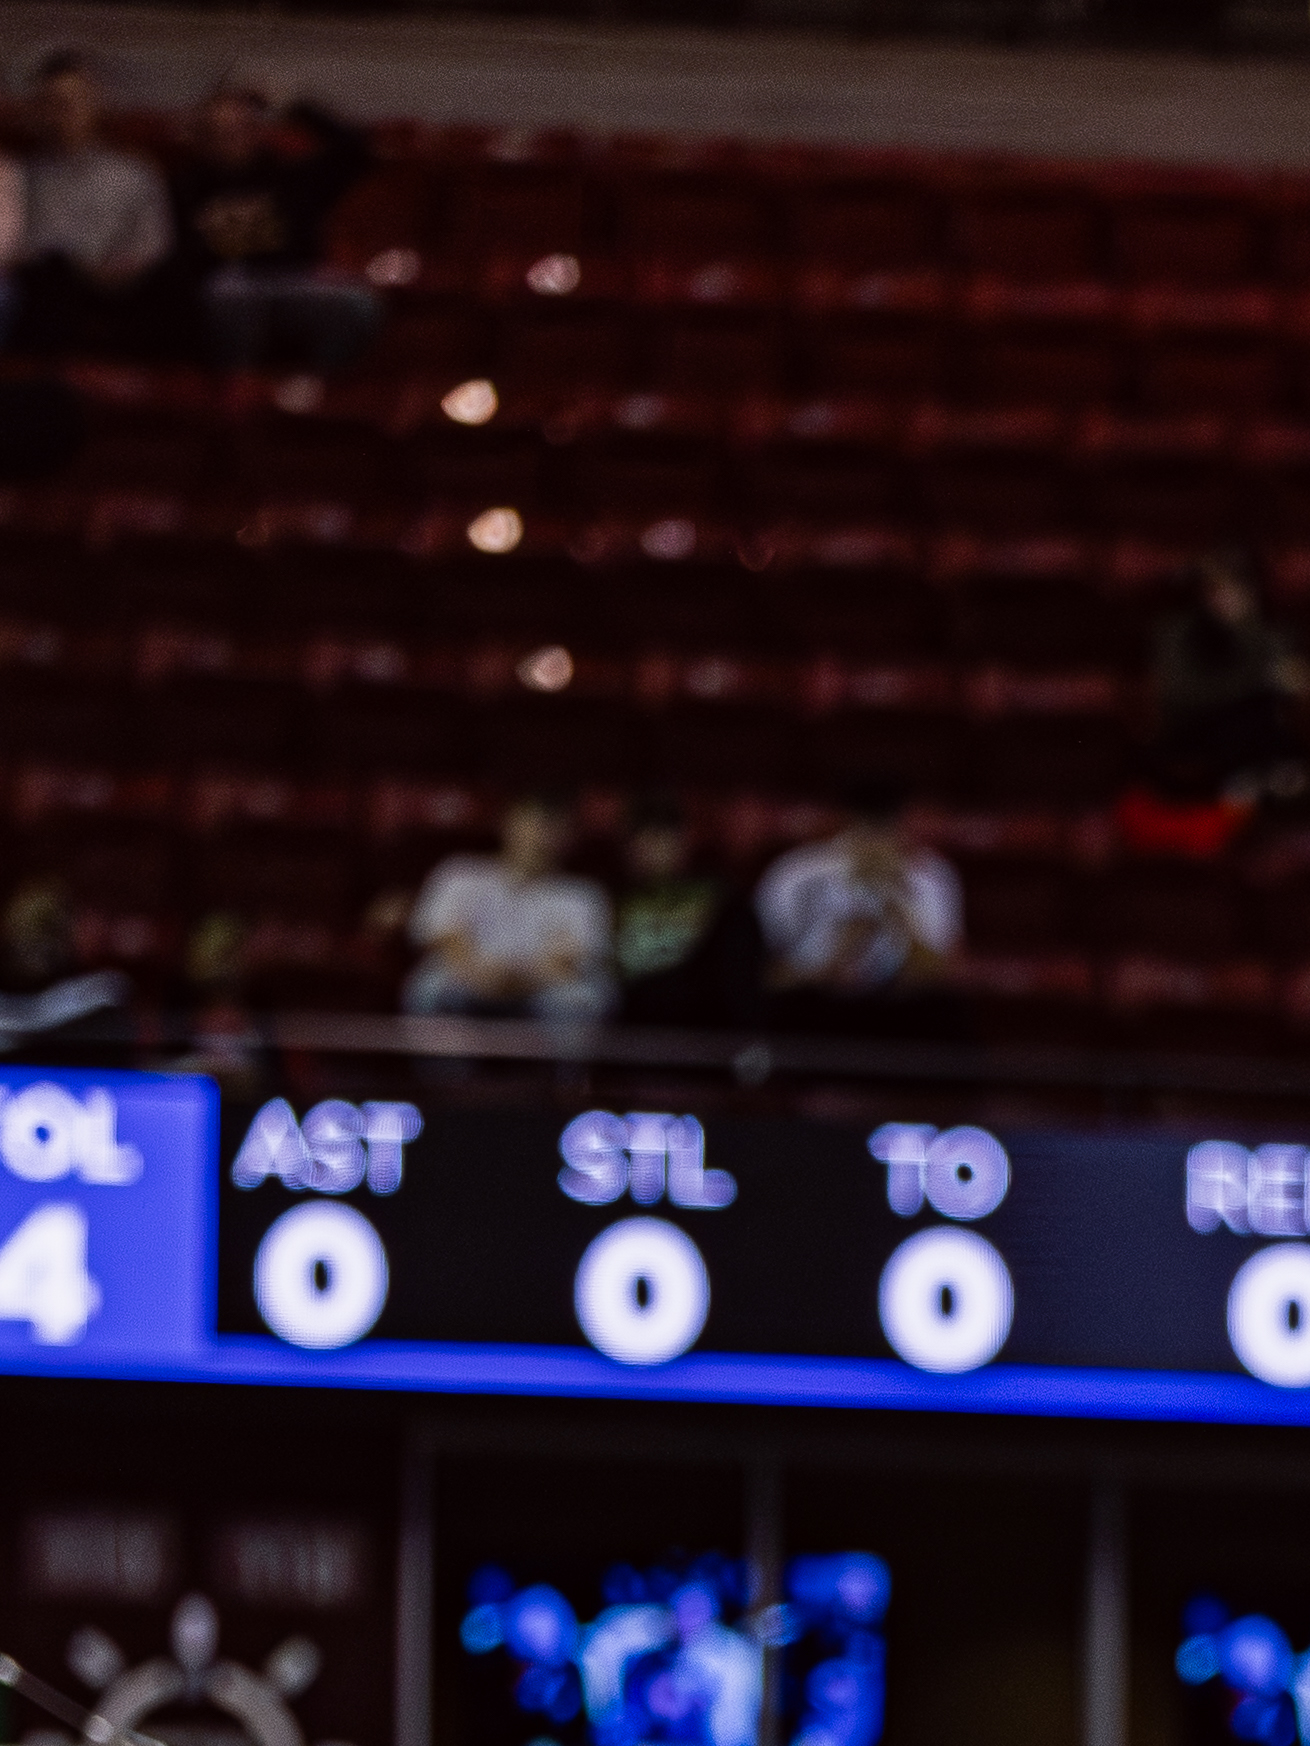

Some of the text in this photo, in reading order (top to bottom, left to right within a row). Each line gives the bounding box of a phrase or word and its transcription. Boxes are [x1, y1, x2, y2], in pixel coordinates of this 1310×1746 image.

[0, 1083, 143, 1186] OL
[234, 1099, 422, 1193] AST
[560, 1111, 737, 1208] STL
[869, 1123, 1010, 1219] TO
[0, 1203, 102, 1346] 4
[254, 1202, 389, 1349] 0
[575, 1217, 710, 1365] 0
[879, 1227, 1014, 1374] 0
